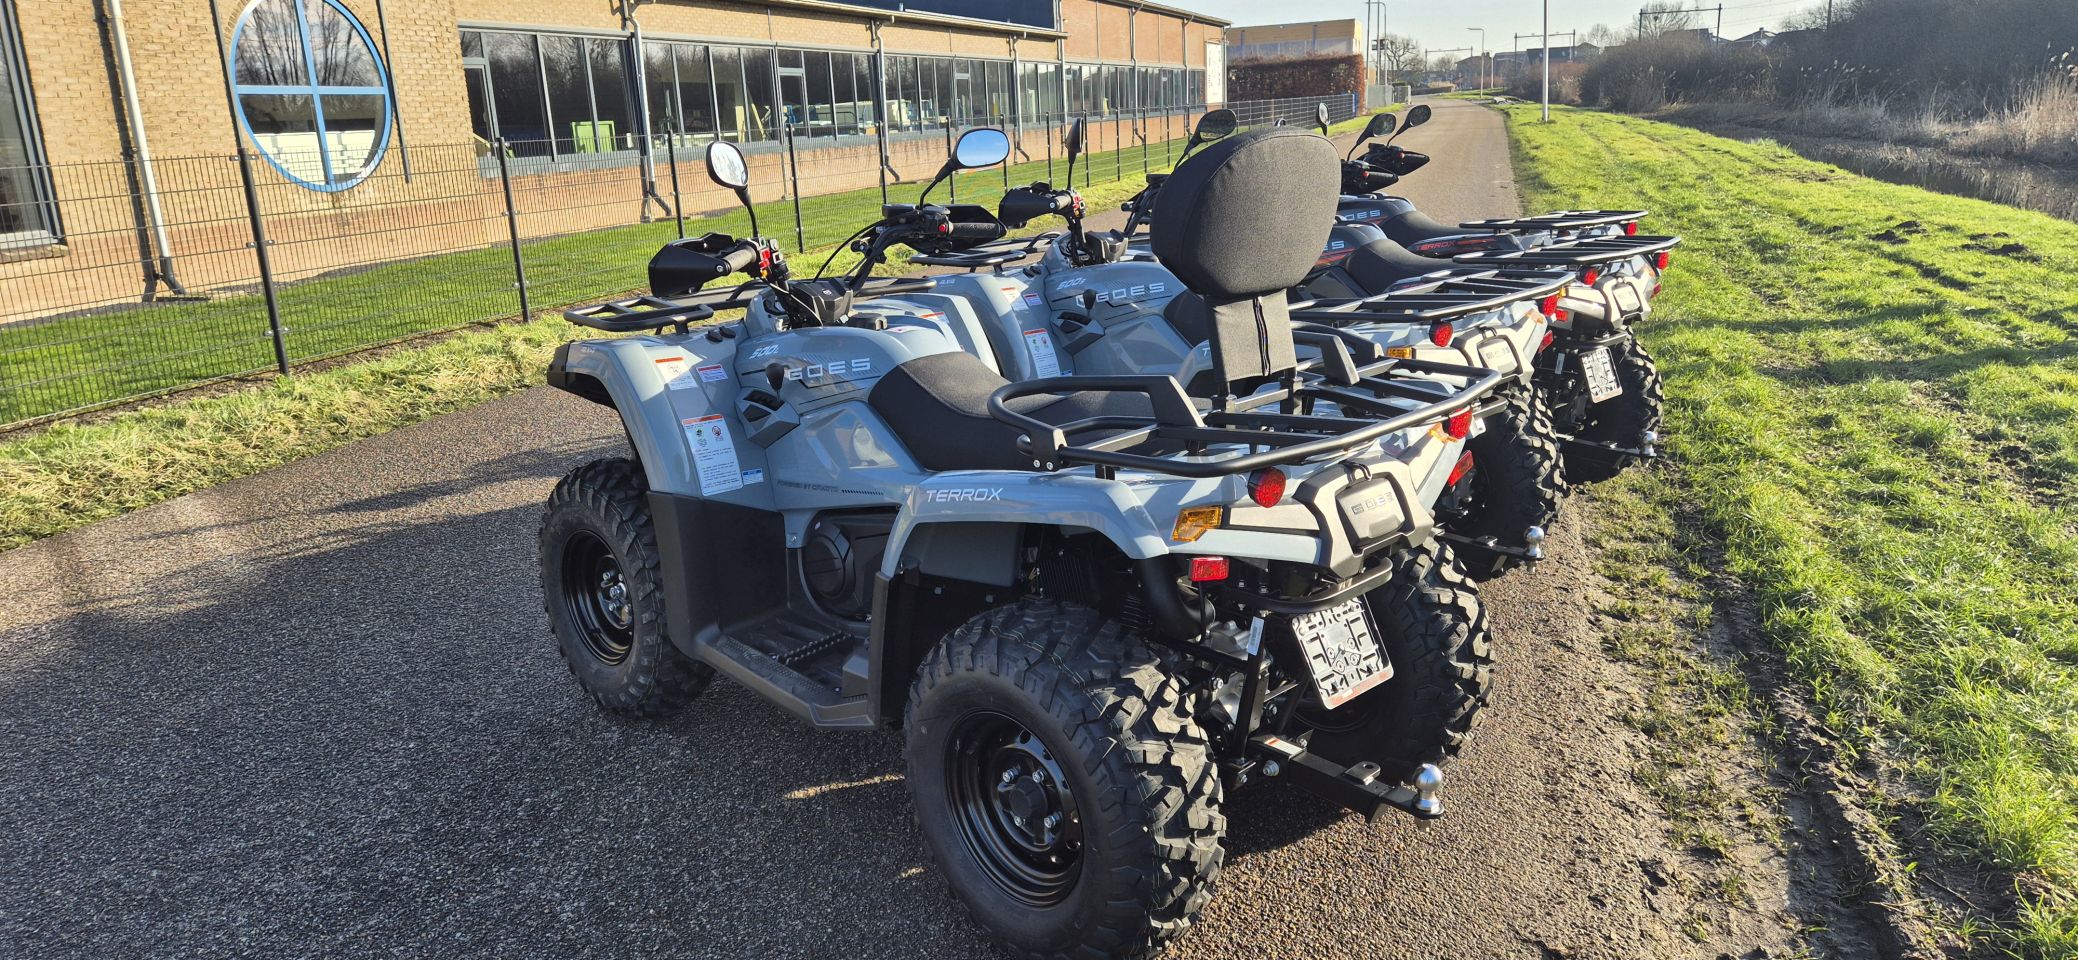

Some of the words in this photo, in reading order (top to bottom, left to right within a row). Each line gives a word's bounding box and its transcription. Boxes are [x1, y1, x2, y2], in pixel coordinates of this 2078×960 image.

[1095, 282, 1165, 303] GOES
[788, 357, 871, 381] GOES
[926, 487, 1004, 503] TERROX
[1351, 491, 1395, 515] GOES
